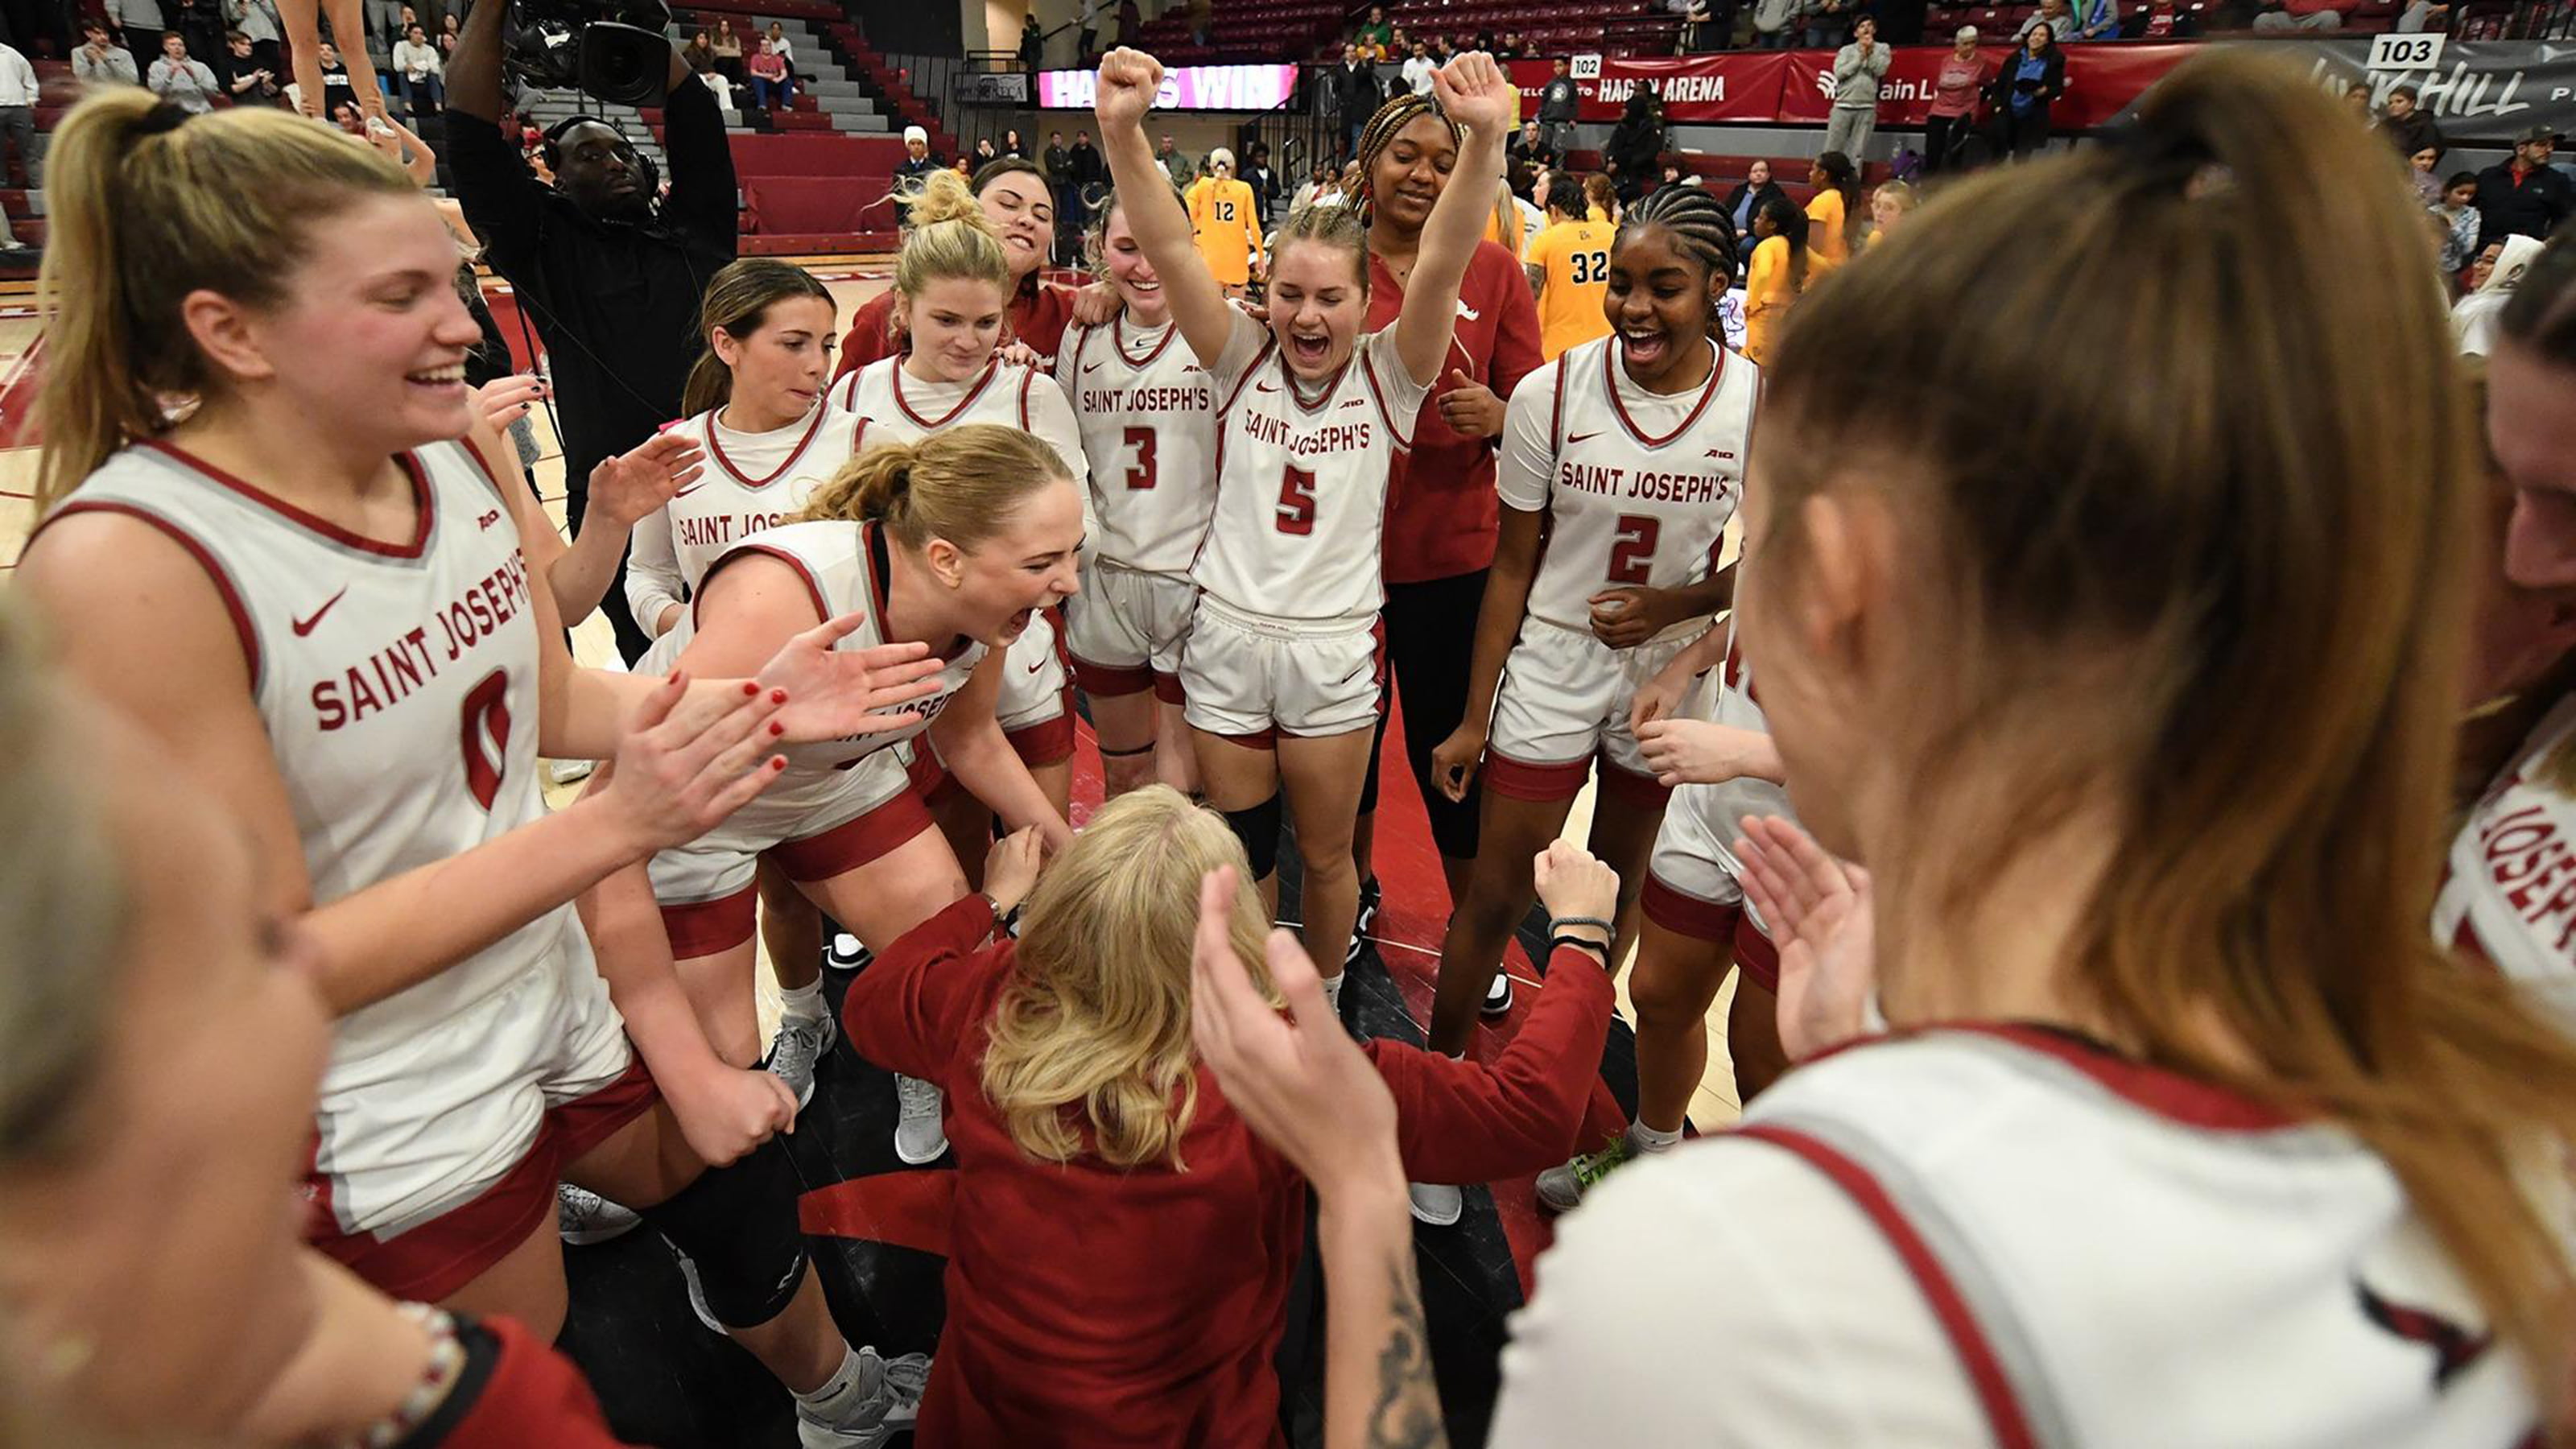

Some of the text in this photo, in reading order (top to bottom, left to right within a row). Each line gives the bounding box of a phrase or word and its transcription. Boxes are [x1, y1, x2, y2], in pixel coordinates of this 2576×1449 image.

[1575, 60, 1597, 73] 102
[2380, 41, 2431, 62] 103
[1053, 68, 1181, 109] HAS
[1191, 65, 1281, 109] WIN
[1576, 87, 1593, 97] TO
[1598, 78, 1660, 102] HAGN
[1662, 76, 1725, 101] ARENA
[1879, 78, 1915, 100] ain
[2416, 60, 2530, 117] HILL
[2550, 87, 2576, 101] P
[1216, 202, 1233, 221] 12
[1571, 251, 1607, 283] 32
[1083, 387, 1208, 413] SAINT JOSEPH'S
[1245, 409, 1370, 456] SAINT JOSEPH'S
[1124, 426, 1158, 489] 3
[1276, 464, 1315, 536] 5
[1561, 462, 1728, 503] SAINT JOSEPH'S
[679, 515, 731, 545] SAINT
[1607, 514, 1661, 584] 2
[312, 626, 438, 731] SAINT
[461, 667, 511, 811] 0
